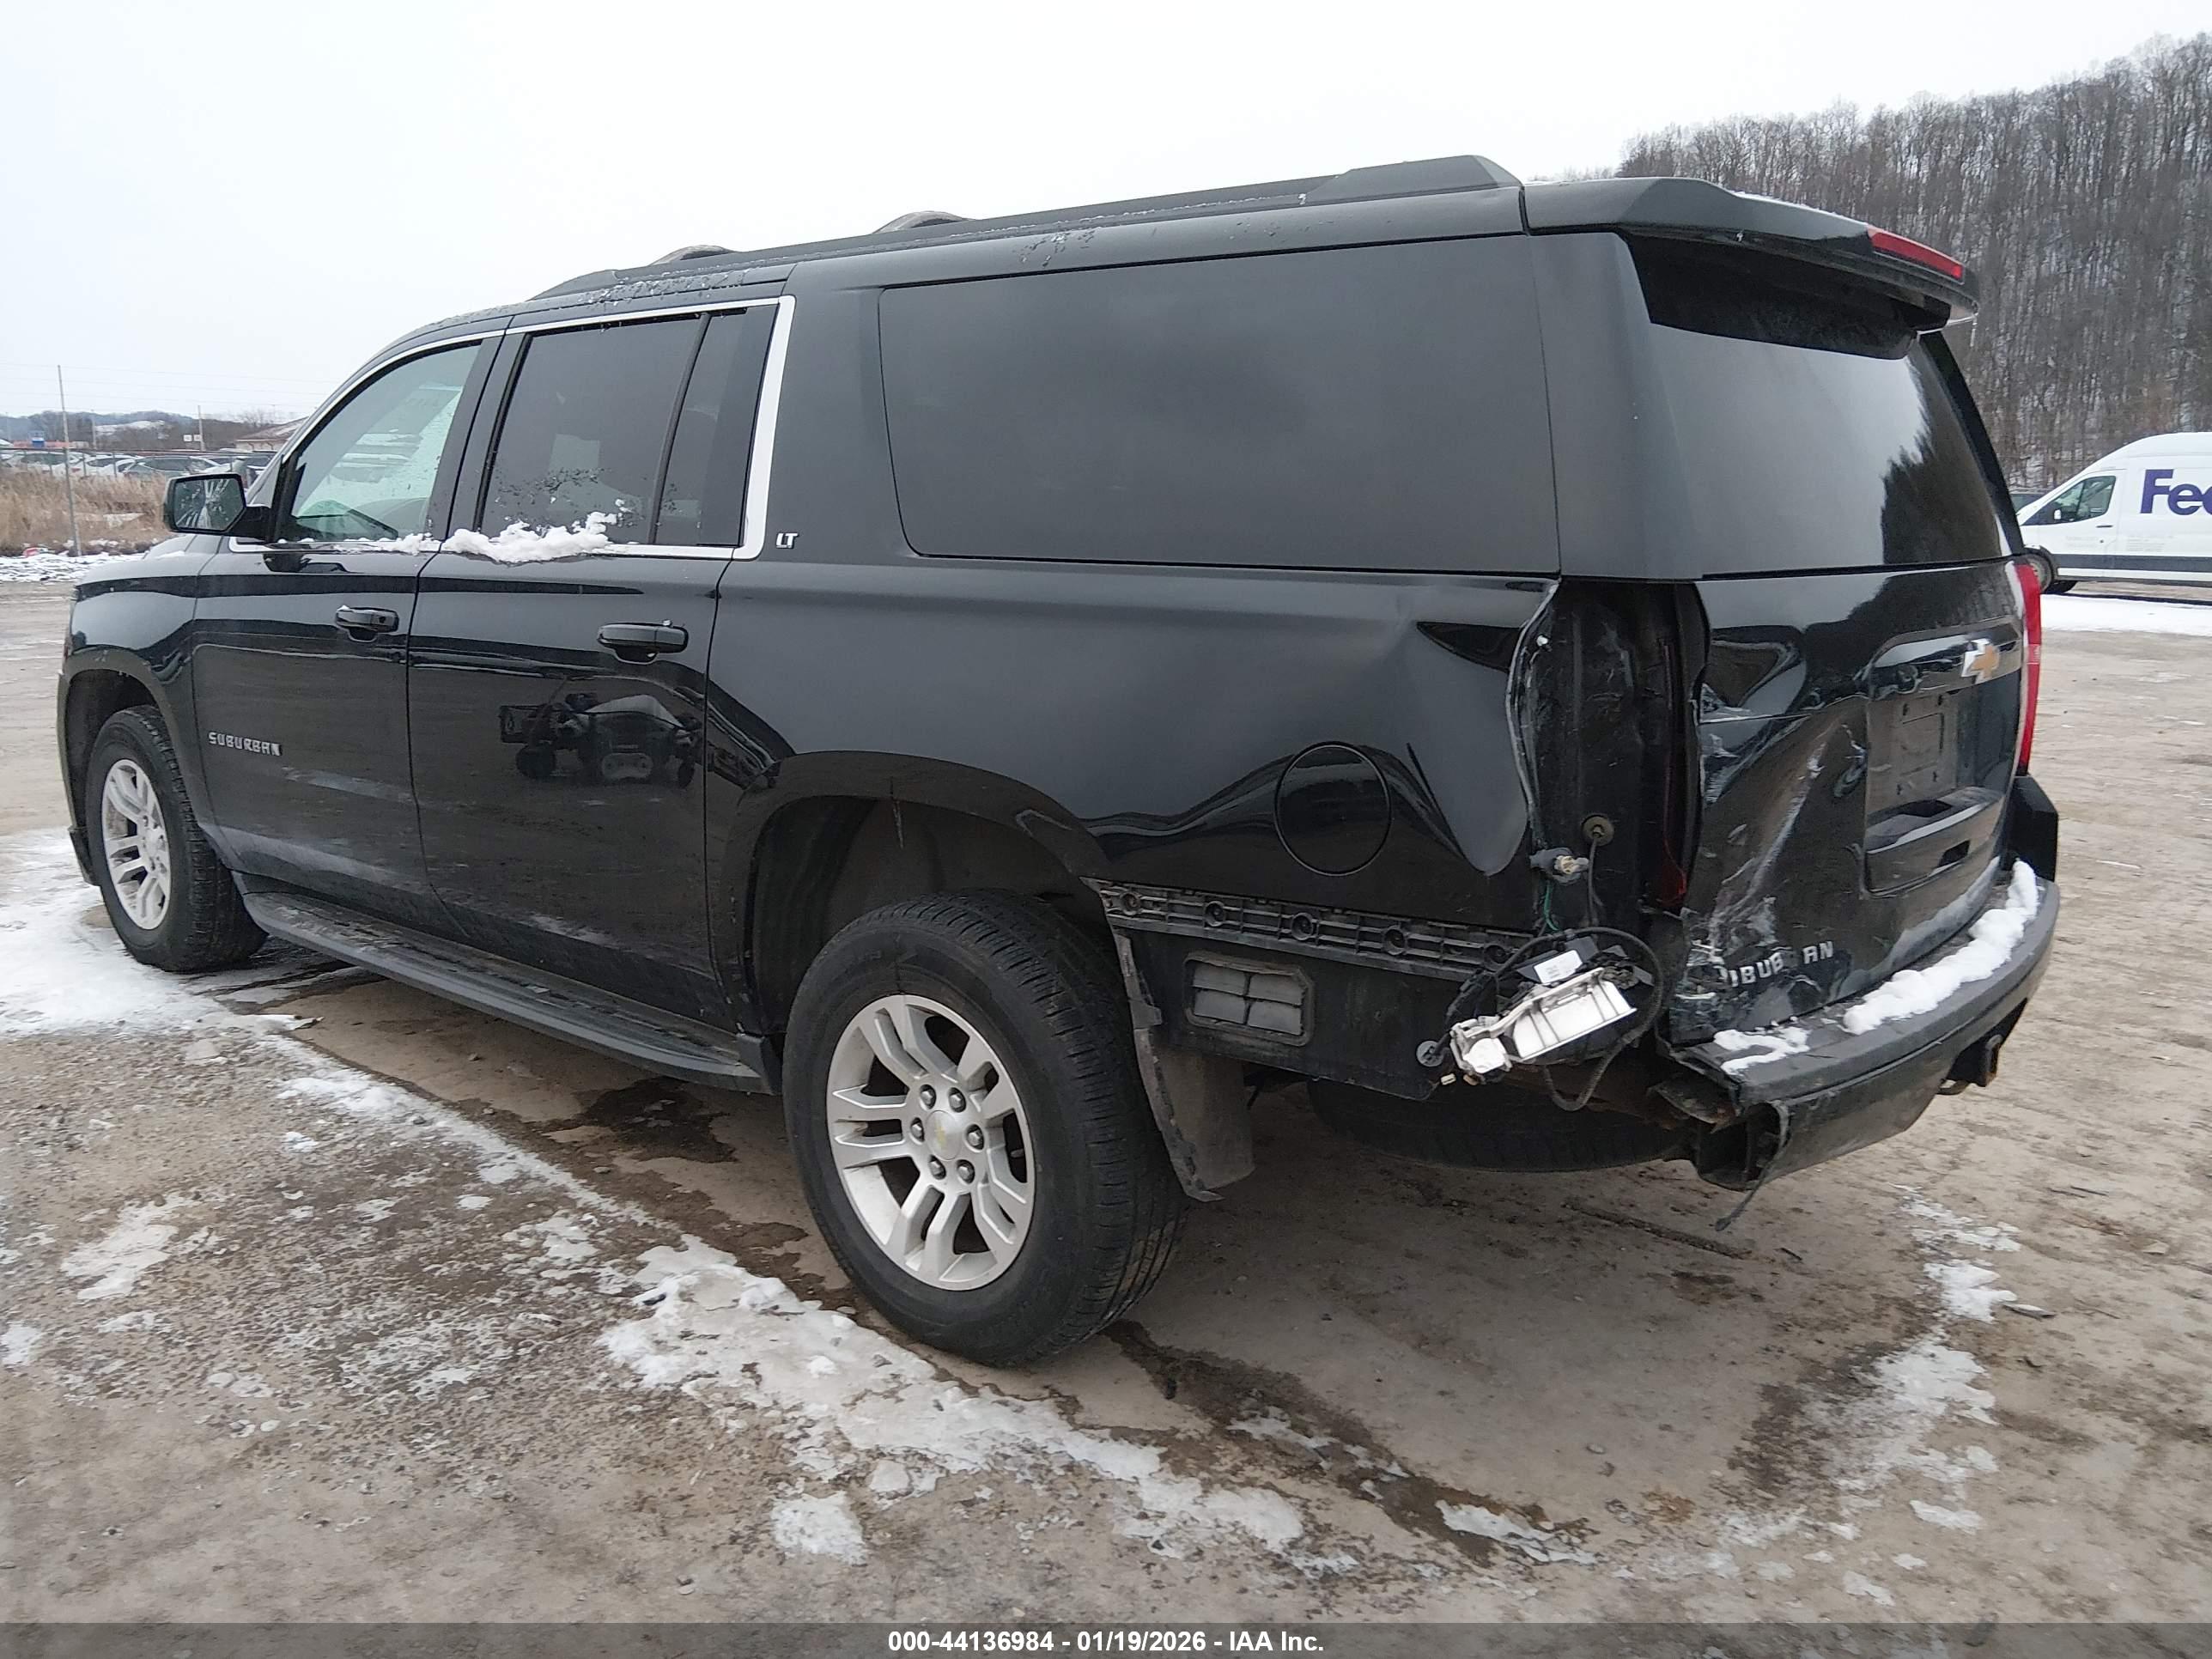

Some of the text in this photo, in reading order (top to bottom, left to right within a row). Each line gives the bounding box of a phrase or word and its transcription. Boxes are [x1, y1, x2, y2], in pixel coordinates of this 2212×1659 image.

[2140, 469, 2212, 516] Fe
[775, 532, 799, 549] LT
[208, 732, 281, 757] SUBURBAN
